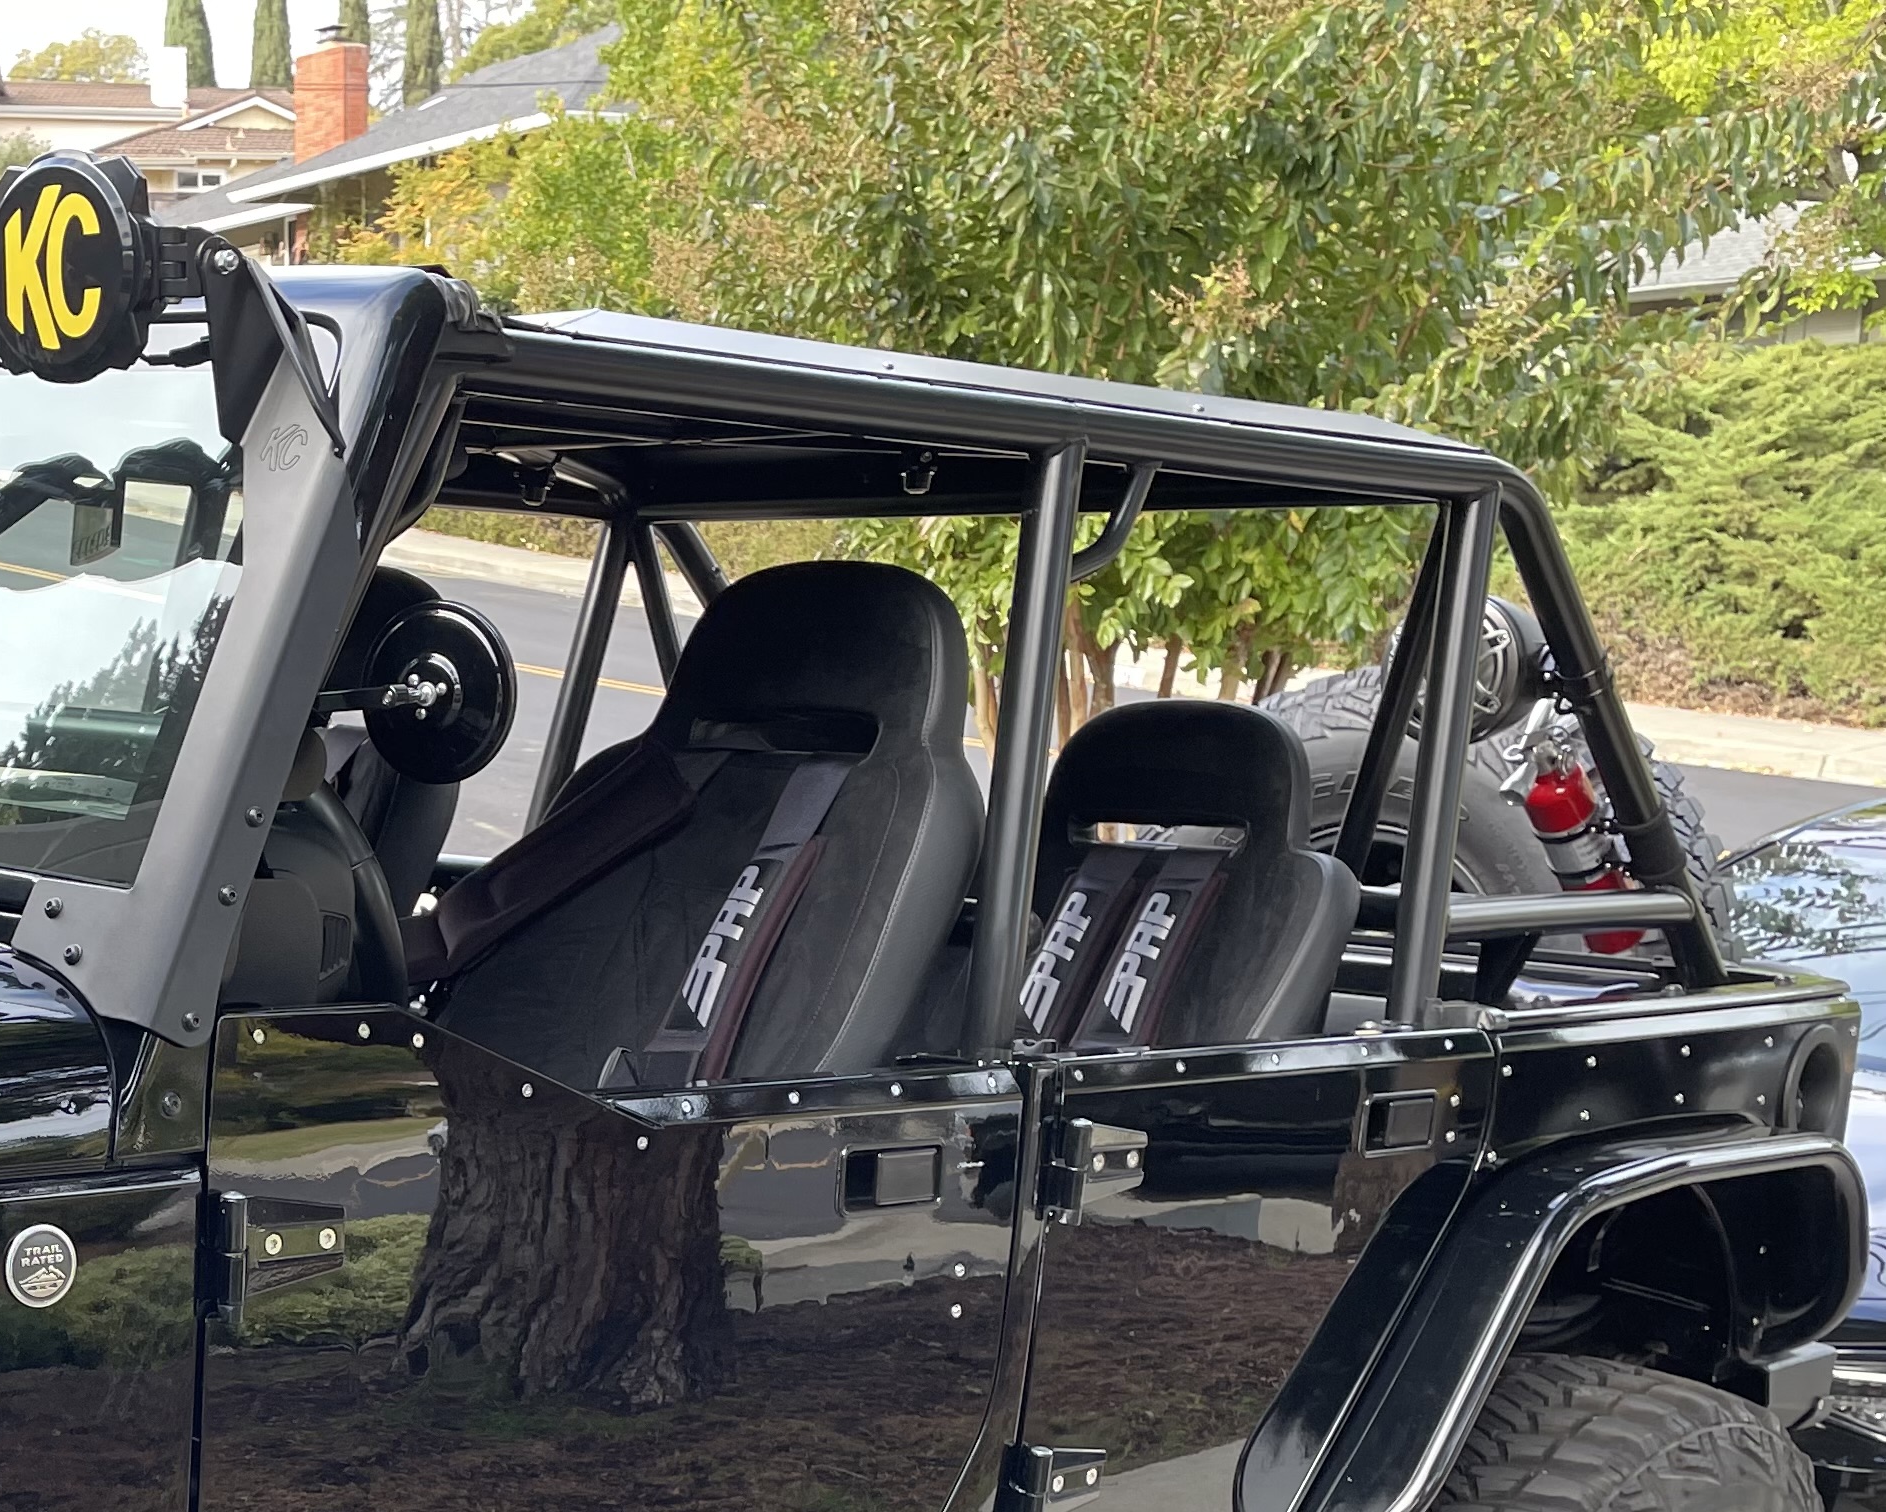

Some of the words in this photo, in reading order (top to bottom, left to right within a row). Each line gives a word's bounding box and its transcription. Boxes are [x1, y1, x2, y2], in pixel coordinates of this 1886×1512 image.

[4, 184, 102, 350] KC
[260, 423, 308, 472] KC
[20, 1253, 64, 1268] RATED
[23, 1243, 63, 1257] TRAIL
